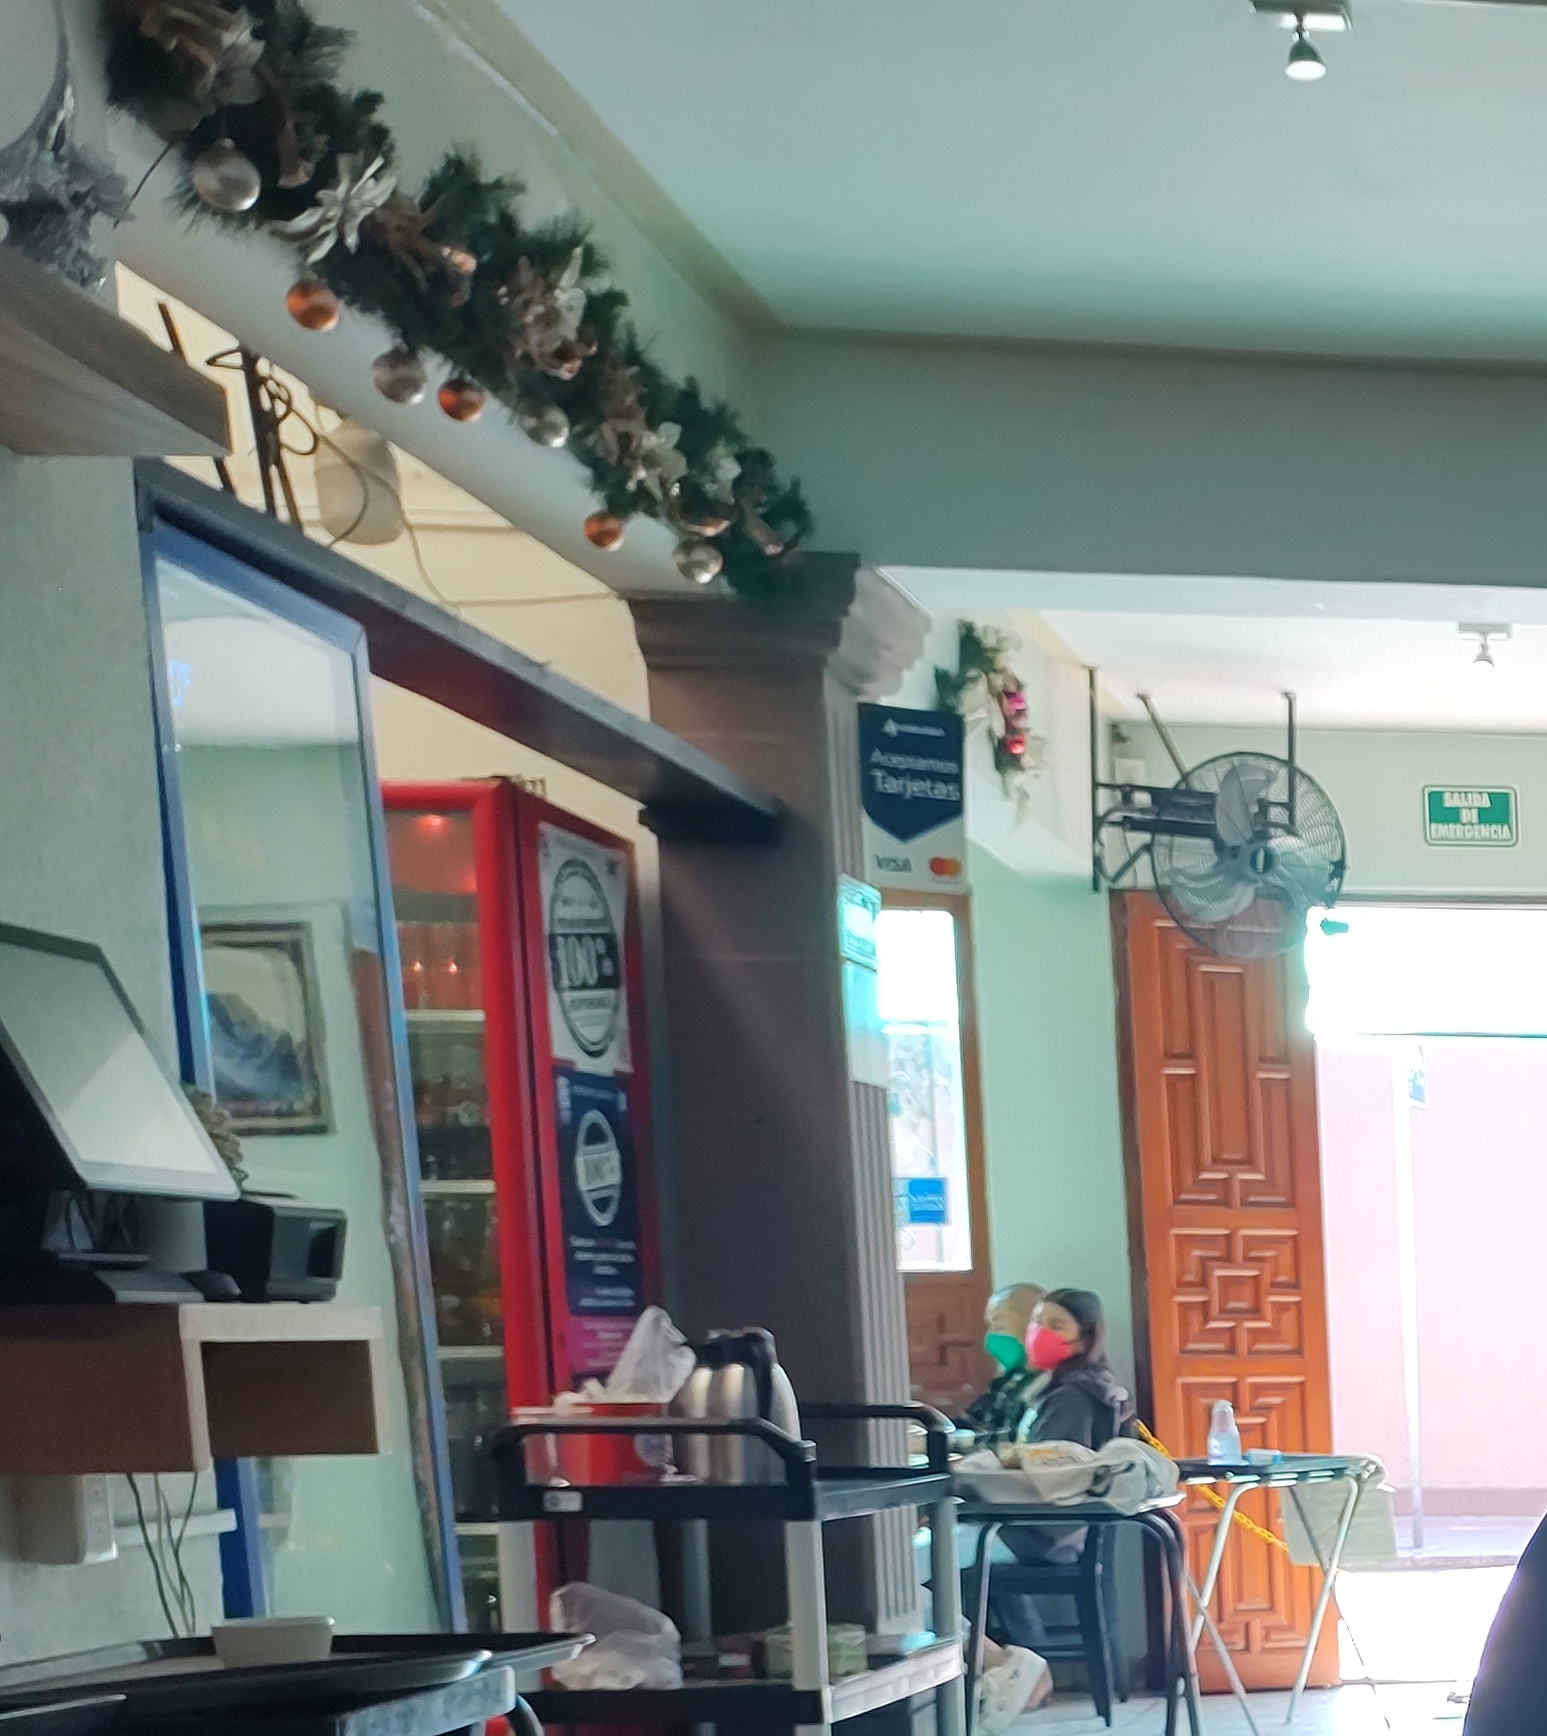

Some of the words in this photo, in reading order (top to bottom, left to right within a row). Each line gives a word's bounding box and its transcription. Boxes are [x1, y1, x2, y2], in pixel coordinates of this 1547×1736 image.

[869, 768, 961, 800] Tarjetas
[1444, 792, 1491, 807] SALIDA
[1460, 808, 1480, 824] DE
[1431, 824, 1512, 839] EMERGENCIA
